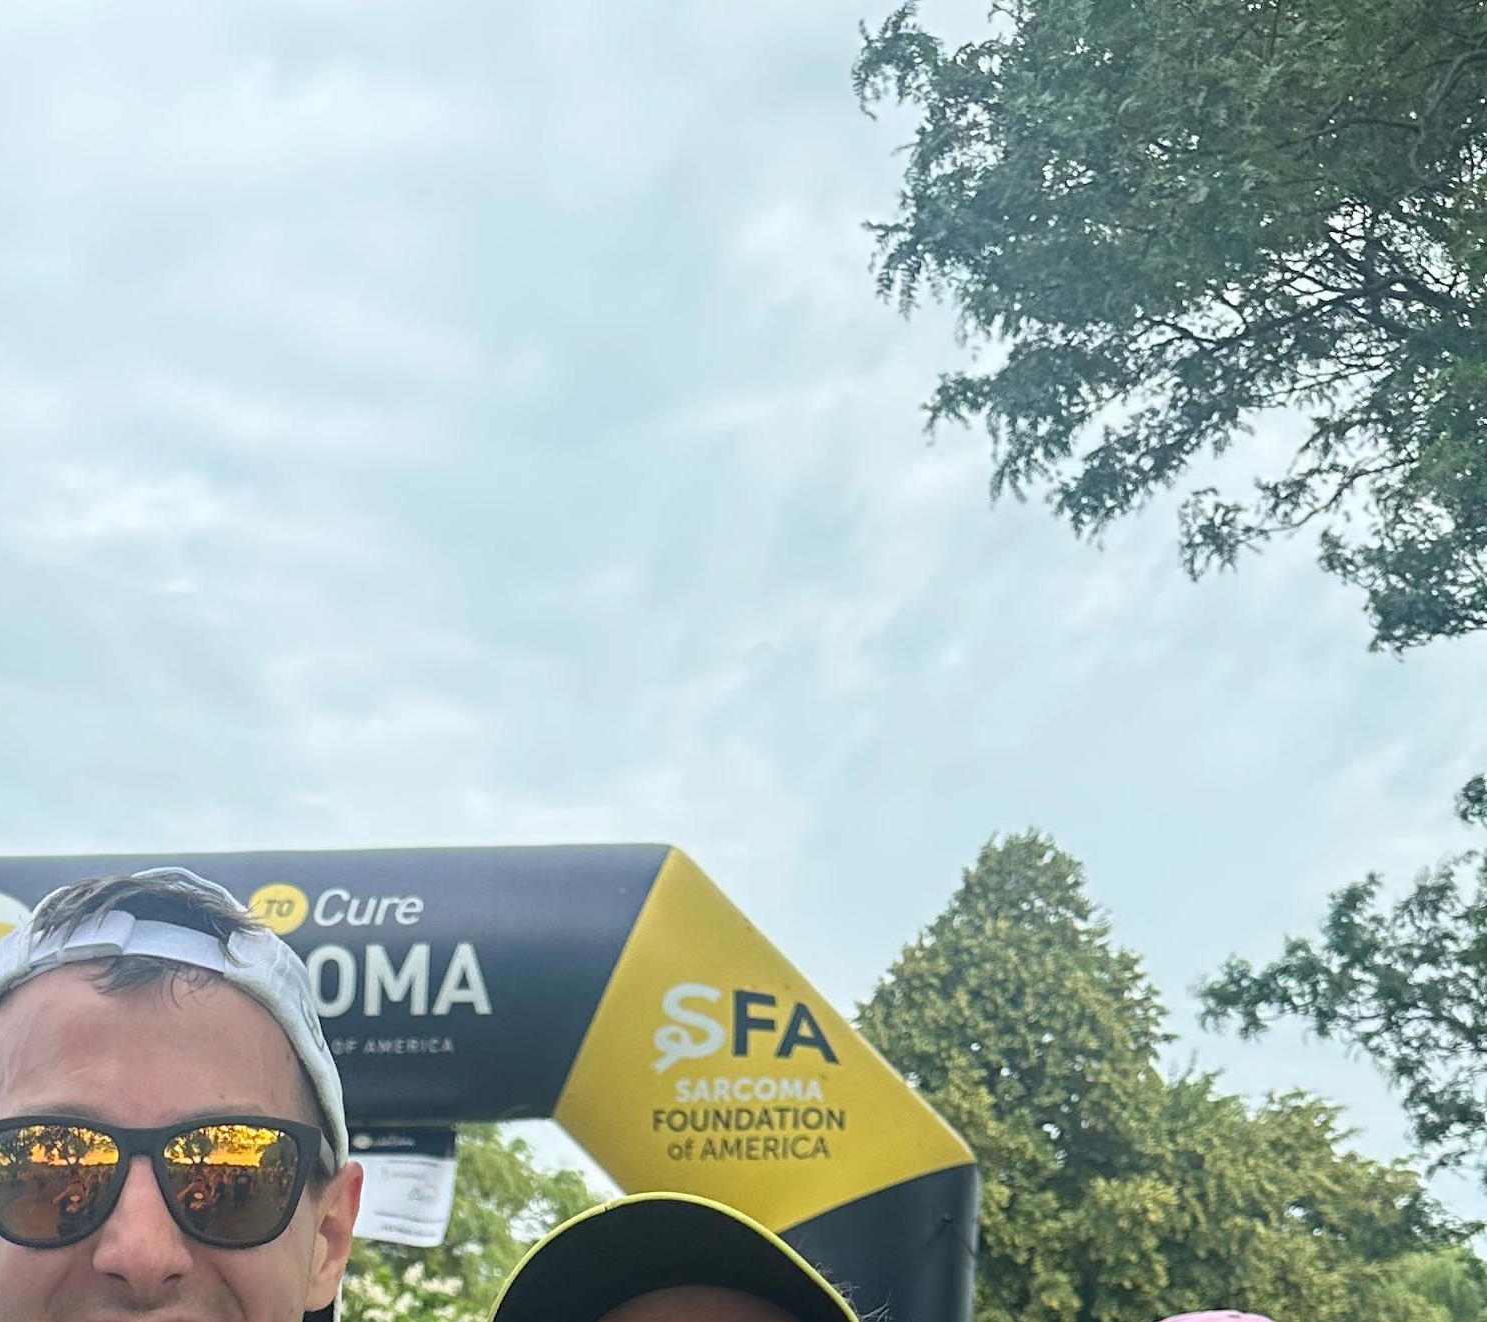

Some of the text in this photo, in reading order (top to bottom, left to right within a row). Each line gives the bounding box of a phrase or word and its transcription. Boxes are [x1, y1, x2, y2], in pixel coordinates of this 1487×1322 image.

[264, 887, 425, 926] TO Cure
[653, 983, 840, 1074] SFA
[675, 1077, 824, 1102] SARCOMA
[652, 1106, 846, 1132] FOUNDATION
[667, 1135, 829, 1161] of AMERICA
